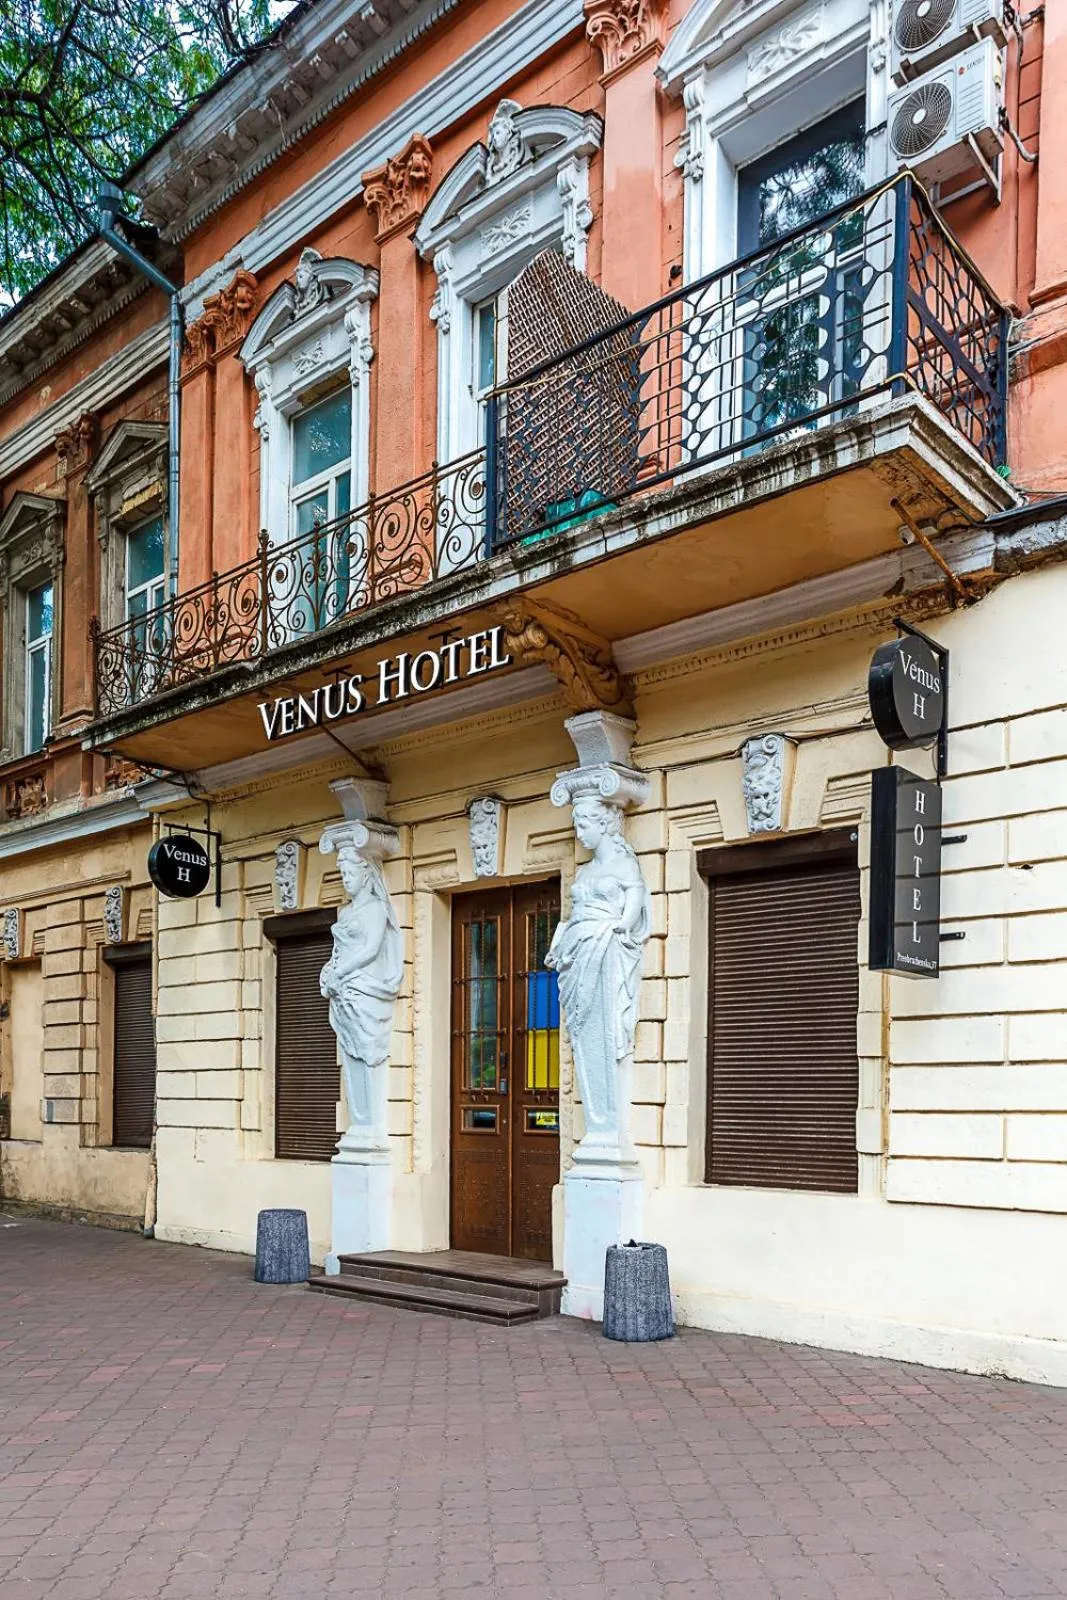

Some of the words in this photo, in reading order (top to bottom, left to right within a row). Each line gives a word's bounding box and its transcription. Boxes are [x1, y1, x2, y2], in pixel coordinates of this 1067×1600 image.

[257, 675, 363, 740] VENUS
[376, 626, 510, 705] HOTEL
[899, 649, 940, 694] Venus
[912, 692, 926, 720] H
[163, 843, 207, 867] Venus
[912, 790, 926, 944] HOTEL
[176, 866, 191, 883] H
